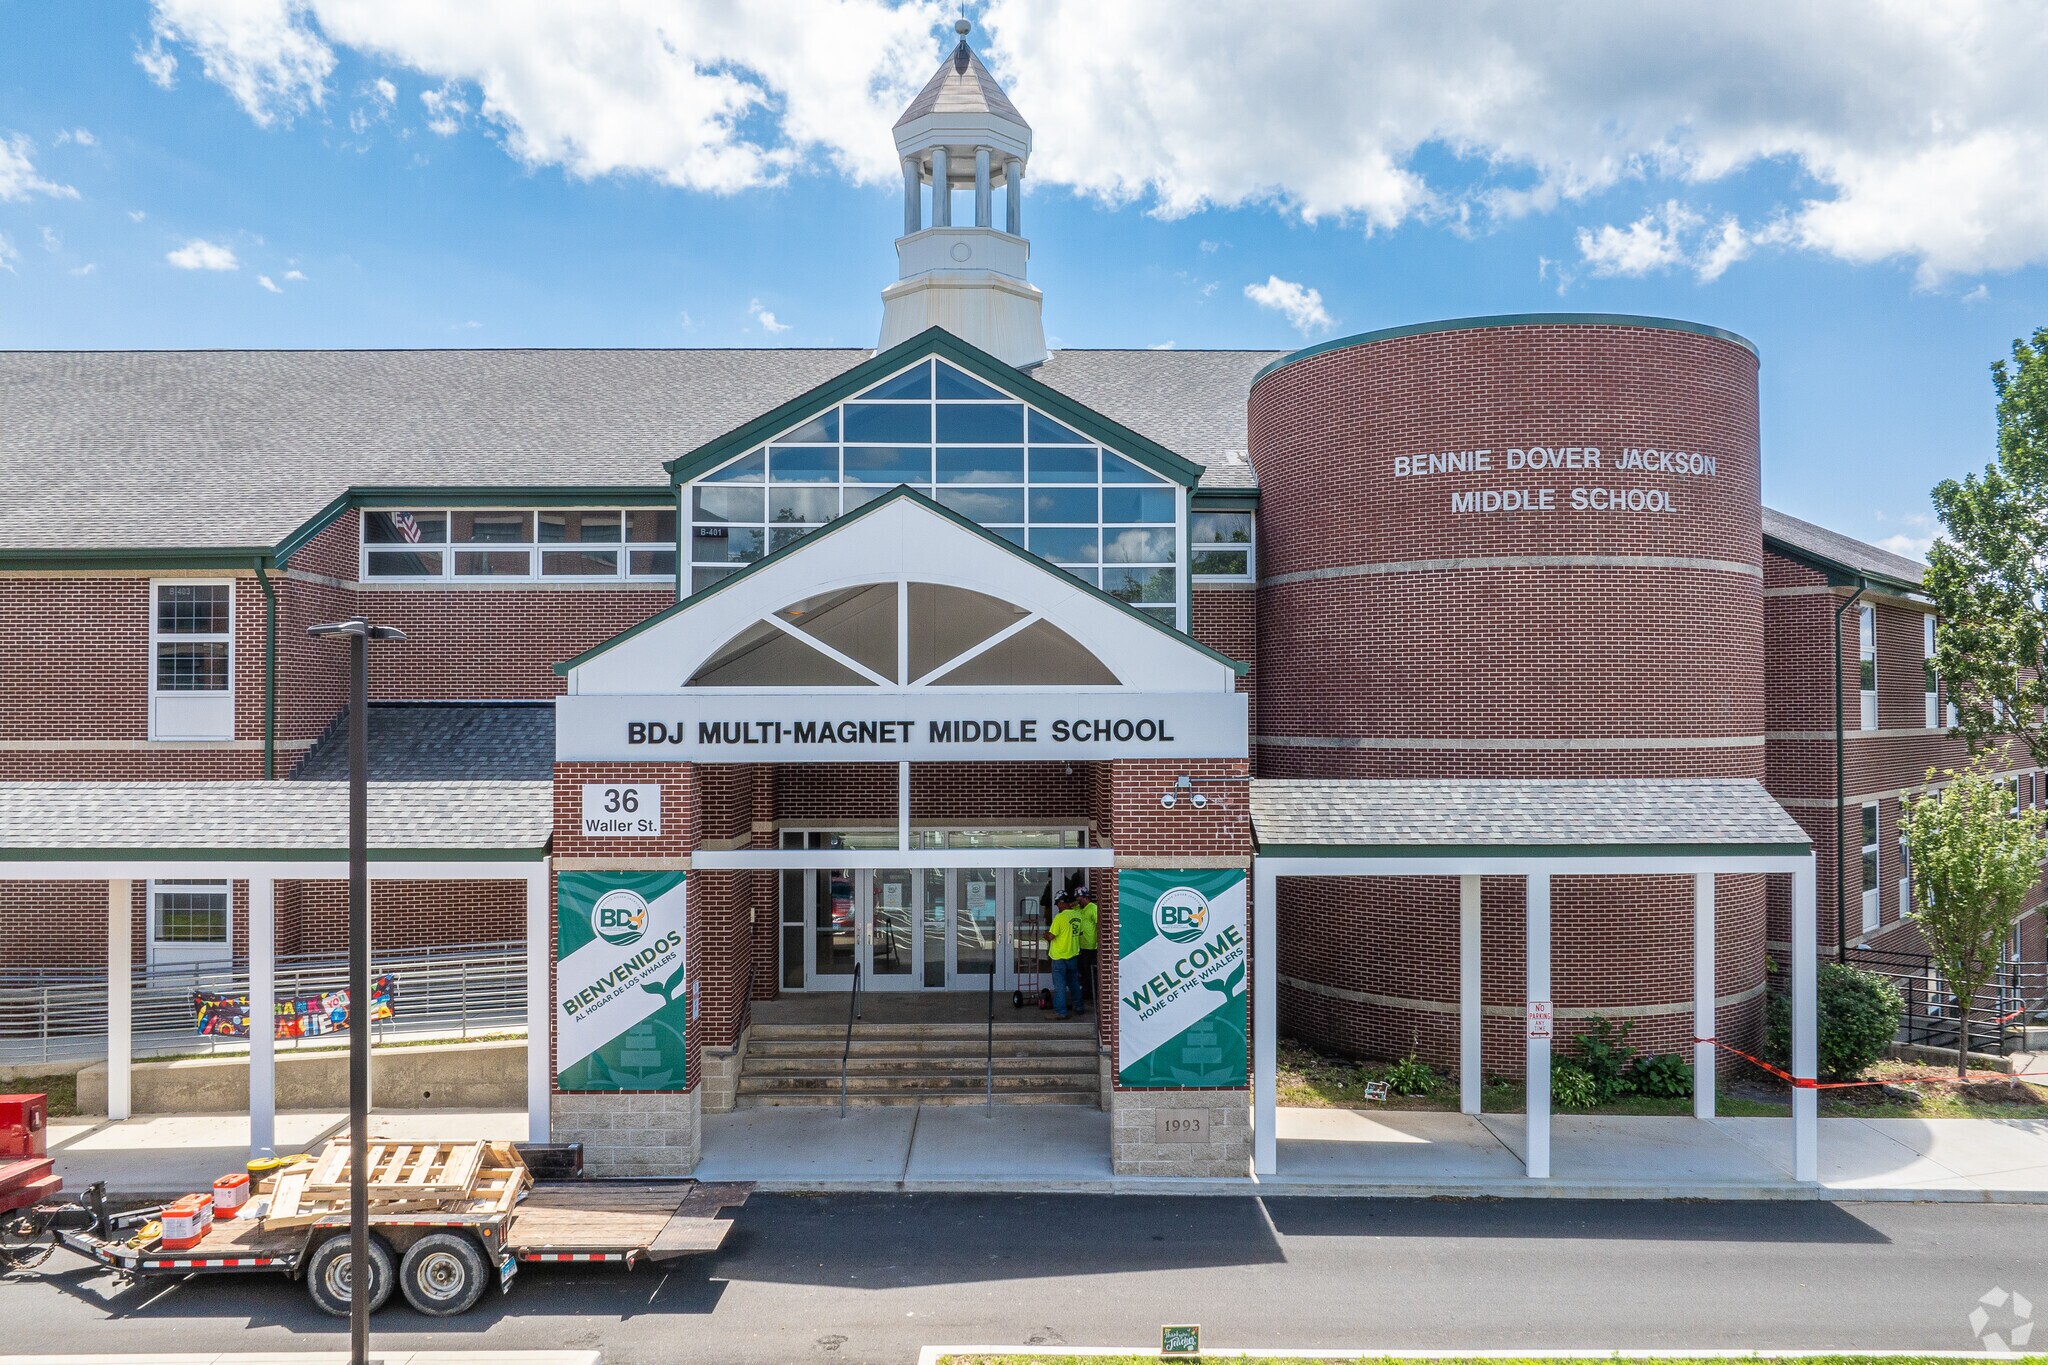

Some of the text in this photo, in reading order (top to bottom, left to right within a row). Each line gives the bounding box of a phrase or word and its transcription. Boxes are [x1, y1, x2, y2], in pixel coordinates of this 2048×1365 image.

[1394, 447, 1716, 477] BENNIE DOVER JACKSON
[1451, 488, 1677, 513] MIDDLE SCHOOL
[700, 528, 722, 536] B-401
[628, 719, 1175, 745] BDJ MULTI-MAGNET MIDDLE SCHOOL
[604, 788, 639, 813] 36
[586, 818, 657, 832] Waller St.
[562, 930, 682, 1017] BIENVENIDOS
[1122, 924, 1244, 1012] WELCOME
[575, 951, 677, 1023] AL HOGAR DE LOS WHALERS
[1138, 947, 1244, 1022] HOME OF THE WHALERS
[274, 994, 346, 1015] HANK YOU
[1165, 1119, 1200, 1132] 1993
